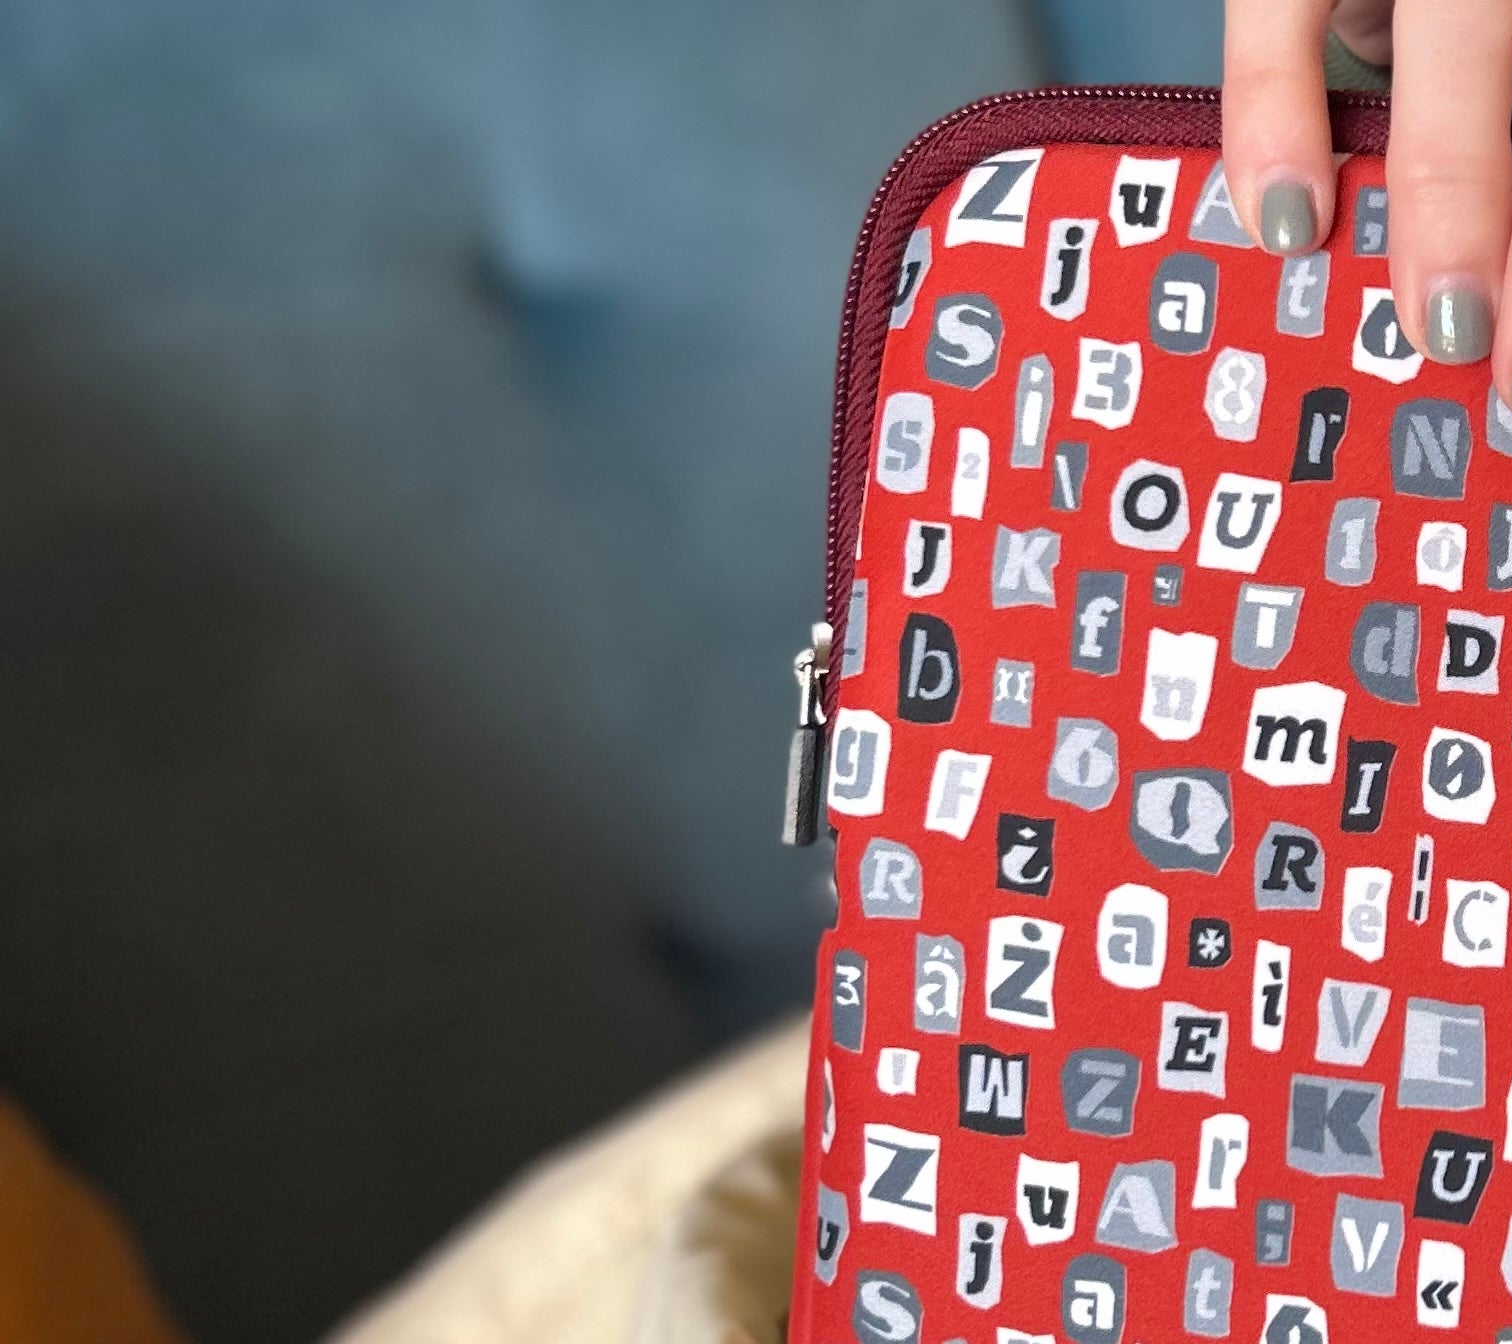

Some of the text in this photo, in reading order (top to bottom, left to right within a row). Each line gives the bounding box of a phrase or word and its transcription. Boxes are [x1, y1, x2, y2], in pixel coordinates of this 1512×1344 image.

[958, 160, 1036, 222] Z
[1051, 226, 1084, 306] j
[1287, 261, 1317, 318] t
[937, 304, 995, 367] S
[1158, 281, 1205, 333] a
[1022, 367, 1043, 446] i
[1085, 350, 1132, 411] 3
[1214, 356, 1256, 424] 8
[1308, 413, 1341, 463] r
[1403, 415, 1460, 479] N
[912, 526, 945, 587] J
[999, 534, 1051, 595] K
[1080, 597, 1119, 657] f
[1245, 588, 1295, 648] T
[1364, 610, 1416, 677] d
[908, 629, 953, 699] b
[1446, 623, 1496, 678] D
[834, 726, 878, 799] g
[1053, 728, 1114, 787] 6
[1254, 715, 1326, 764] m
[936, 760, 977, 819] F
[1137, 777, 1228, 854] Q
[867, 850, 915, 903] R
[1262, 835, 1318, 893] R
[1108, 914, 1154, 966] a
[1453, 890, 1497, 951] C
[1165, 1017, 1221, 1072] E
[1403, 1010, 1479, 1086] E
[966, 1055, 1022, 1118] W
[1077, 1060, 1125, 1122] Z
[1291, 1083, 1375, 1157] K
[868, 1138, 935, 1212] Z
[1209, 1138, 1241, 1190] r
[1100, 1176, 1170, 1237] A
[966, 1222, 994, 1294] j
[861, 1281, 915, 1340] S
[1071, 1280, 1115, 1329] a
[1193, 1267, 1221, 1319] t
